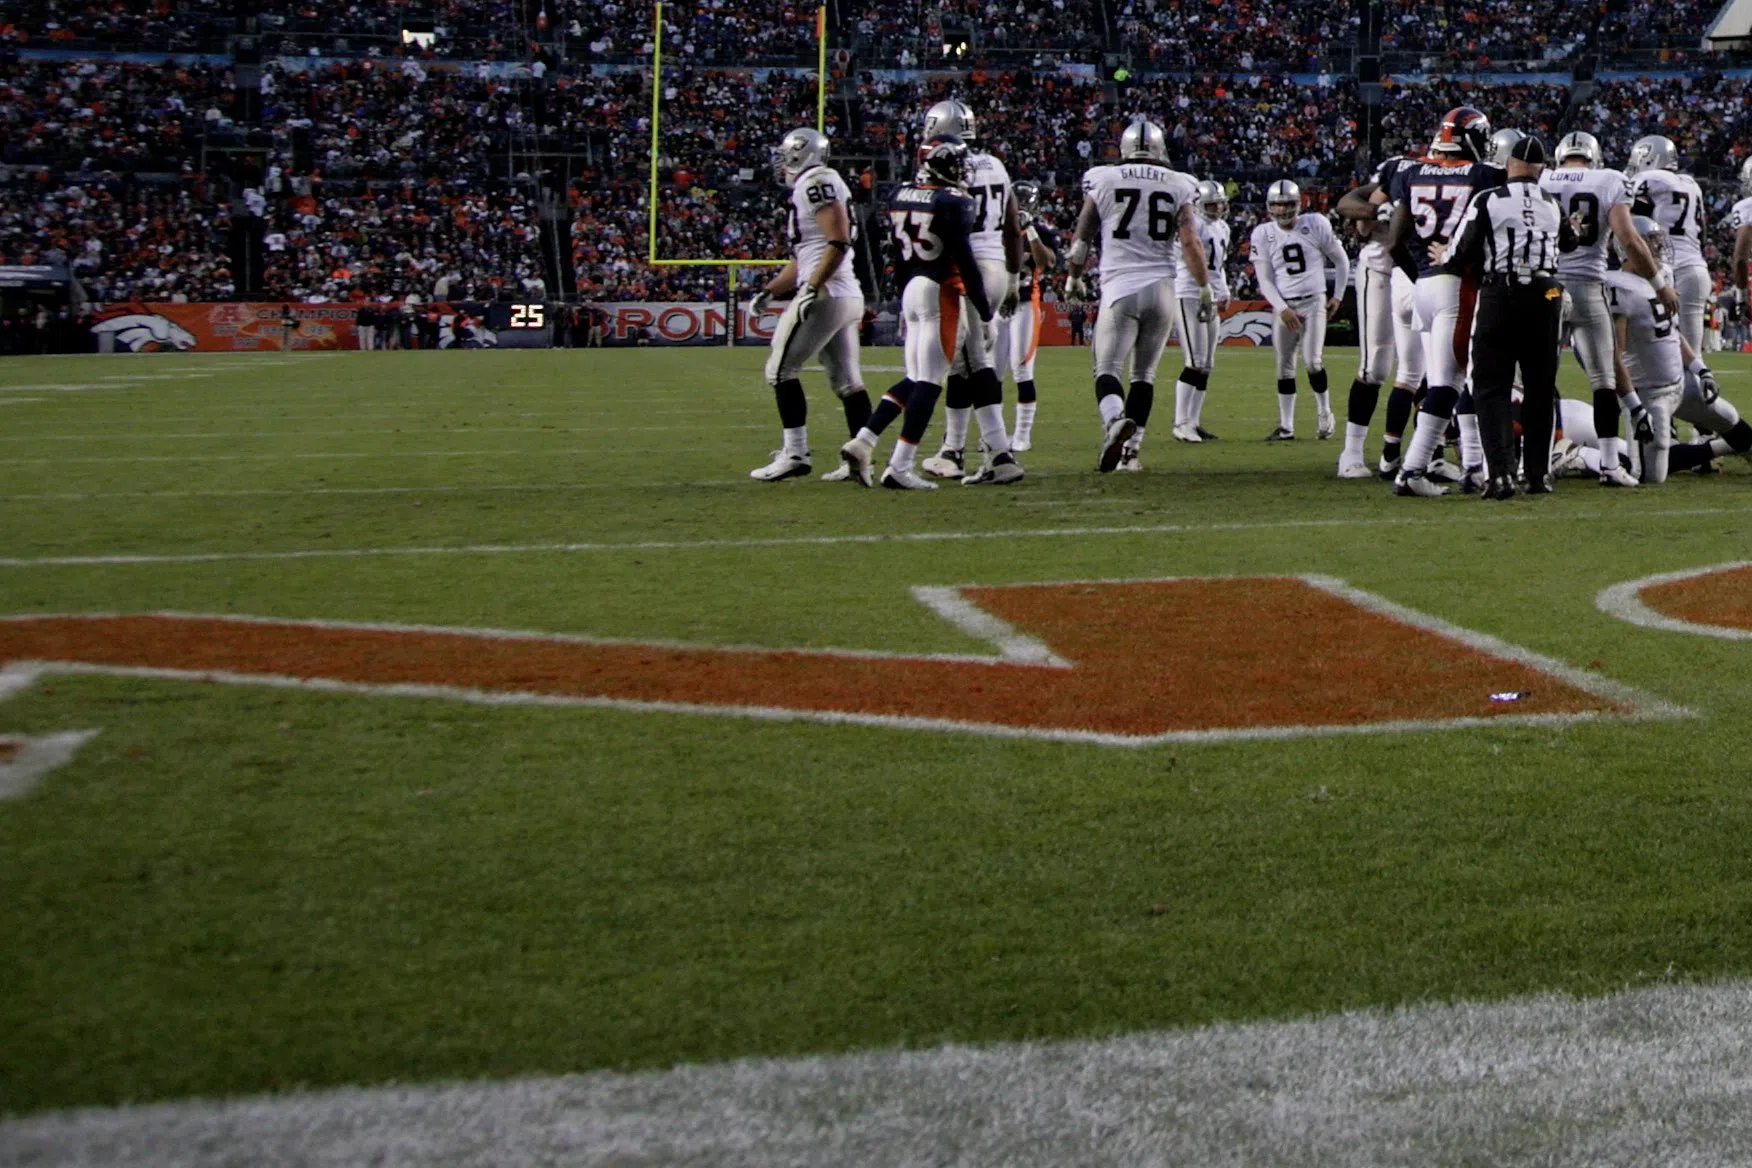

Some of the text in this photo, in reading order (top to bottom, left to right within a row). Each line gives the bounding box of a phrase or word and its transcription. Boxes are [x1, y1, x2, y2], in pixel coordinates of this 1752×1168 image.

[1121, 167, 1166, 182] GALLERY
[806, 183, 836, 203] 80
[1112, 188, 1175, 241] 76
[1410, 185, 1474, 239] 57
[890, 211, 944, 261] 33
[1283, 243, 1306, 276] 9
[510, 305, 543, 327] 25
